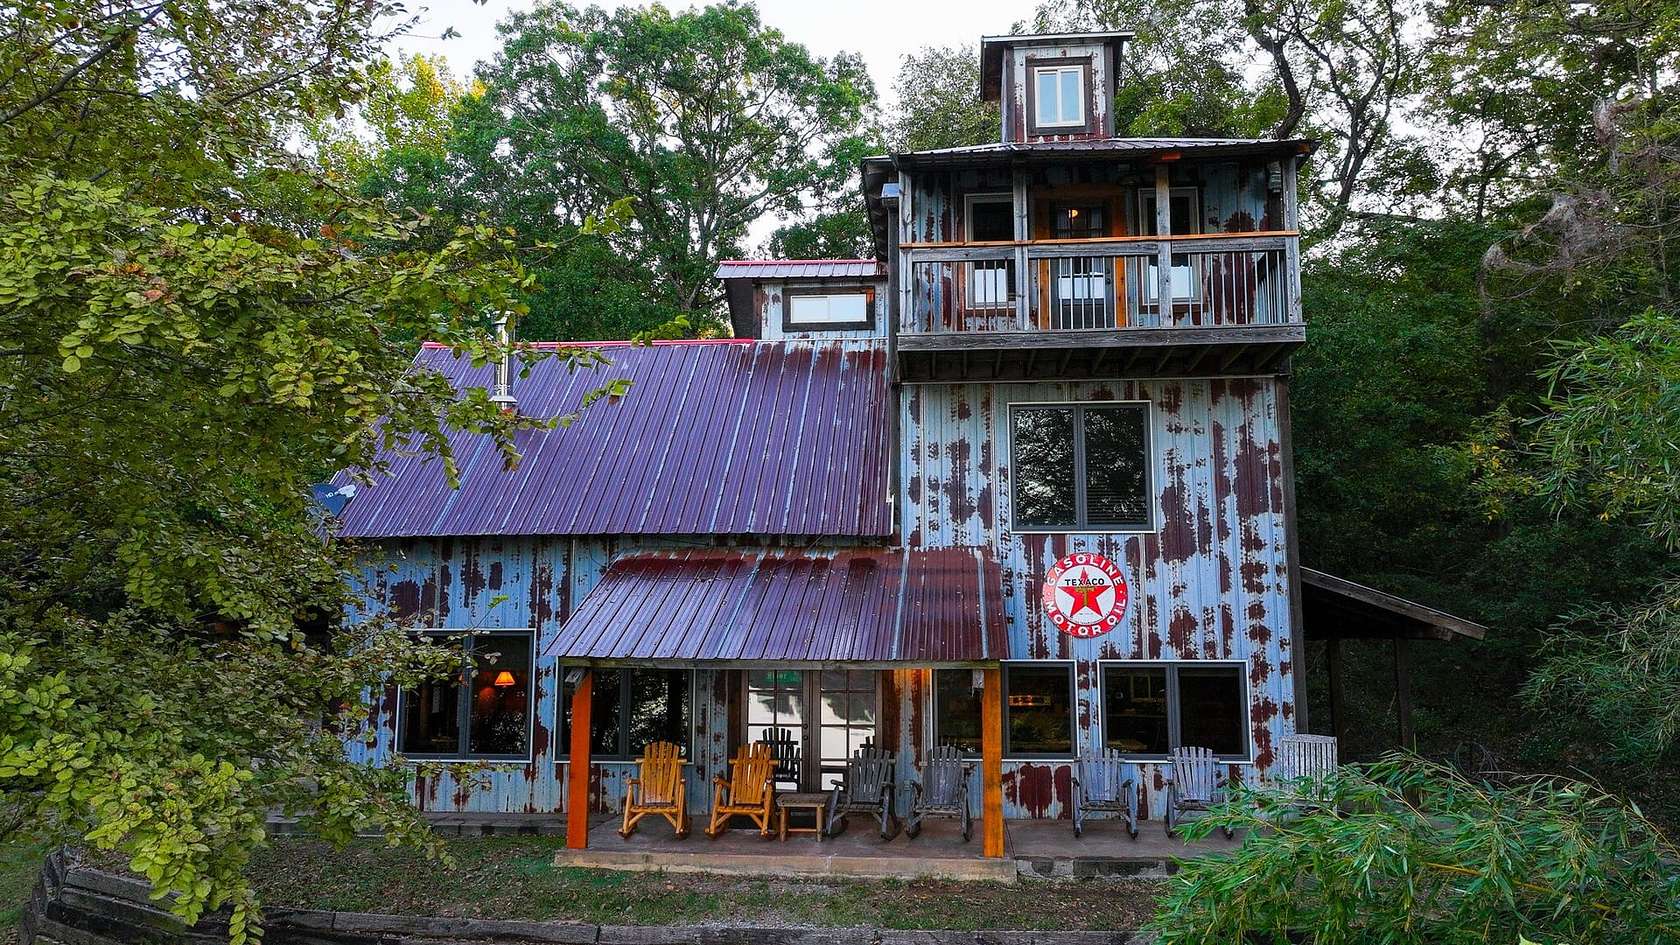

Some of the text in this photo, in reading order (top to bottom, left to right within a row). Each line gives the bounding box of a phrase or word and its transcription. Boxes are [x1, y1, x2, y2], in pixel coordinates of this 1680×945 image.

[1047, 554, 1124, 586] GASOLINE
[1064, 578, 1105, 586] TEXACO
[1045, 599, 1126, 635] MOTOR OIL
